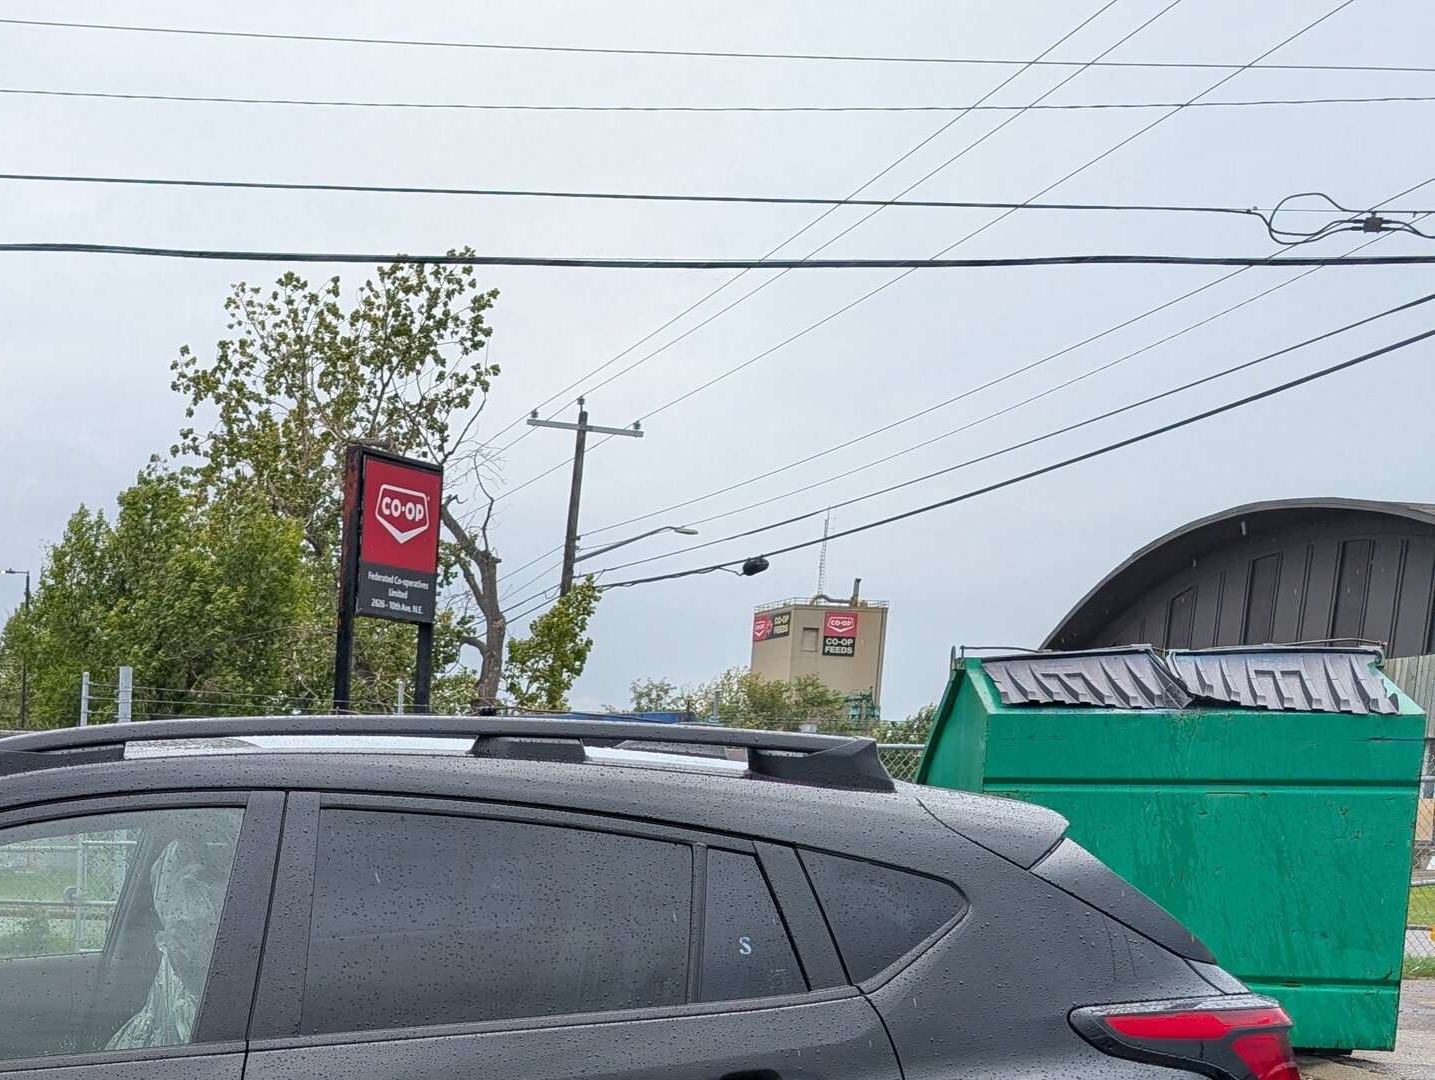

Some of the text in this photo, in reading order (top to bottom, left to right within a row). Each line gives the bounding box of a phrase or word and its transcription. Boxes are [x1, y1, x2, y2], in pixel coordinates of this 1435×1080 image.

[381, 496, 425, 522] CO-OP
[367, 571, 394, 584] Federated
[824, 646, 853, 654] FEEDS
